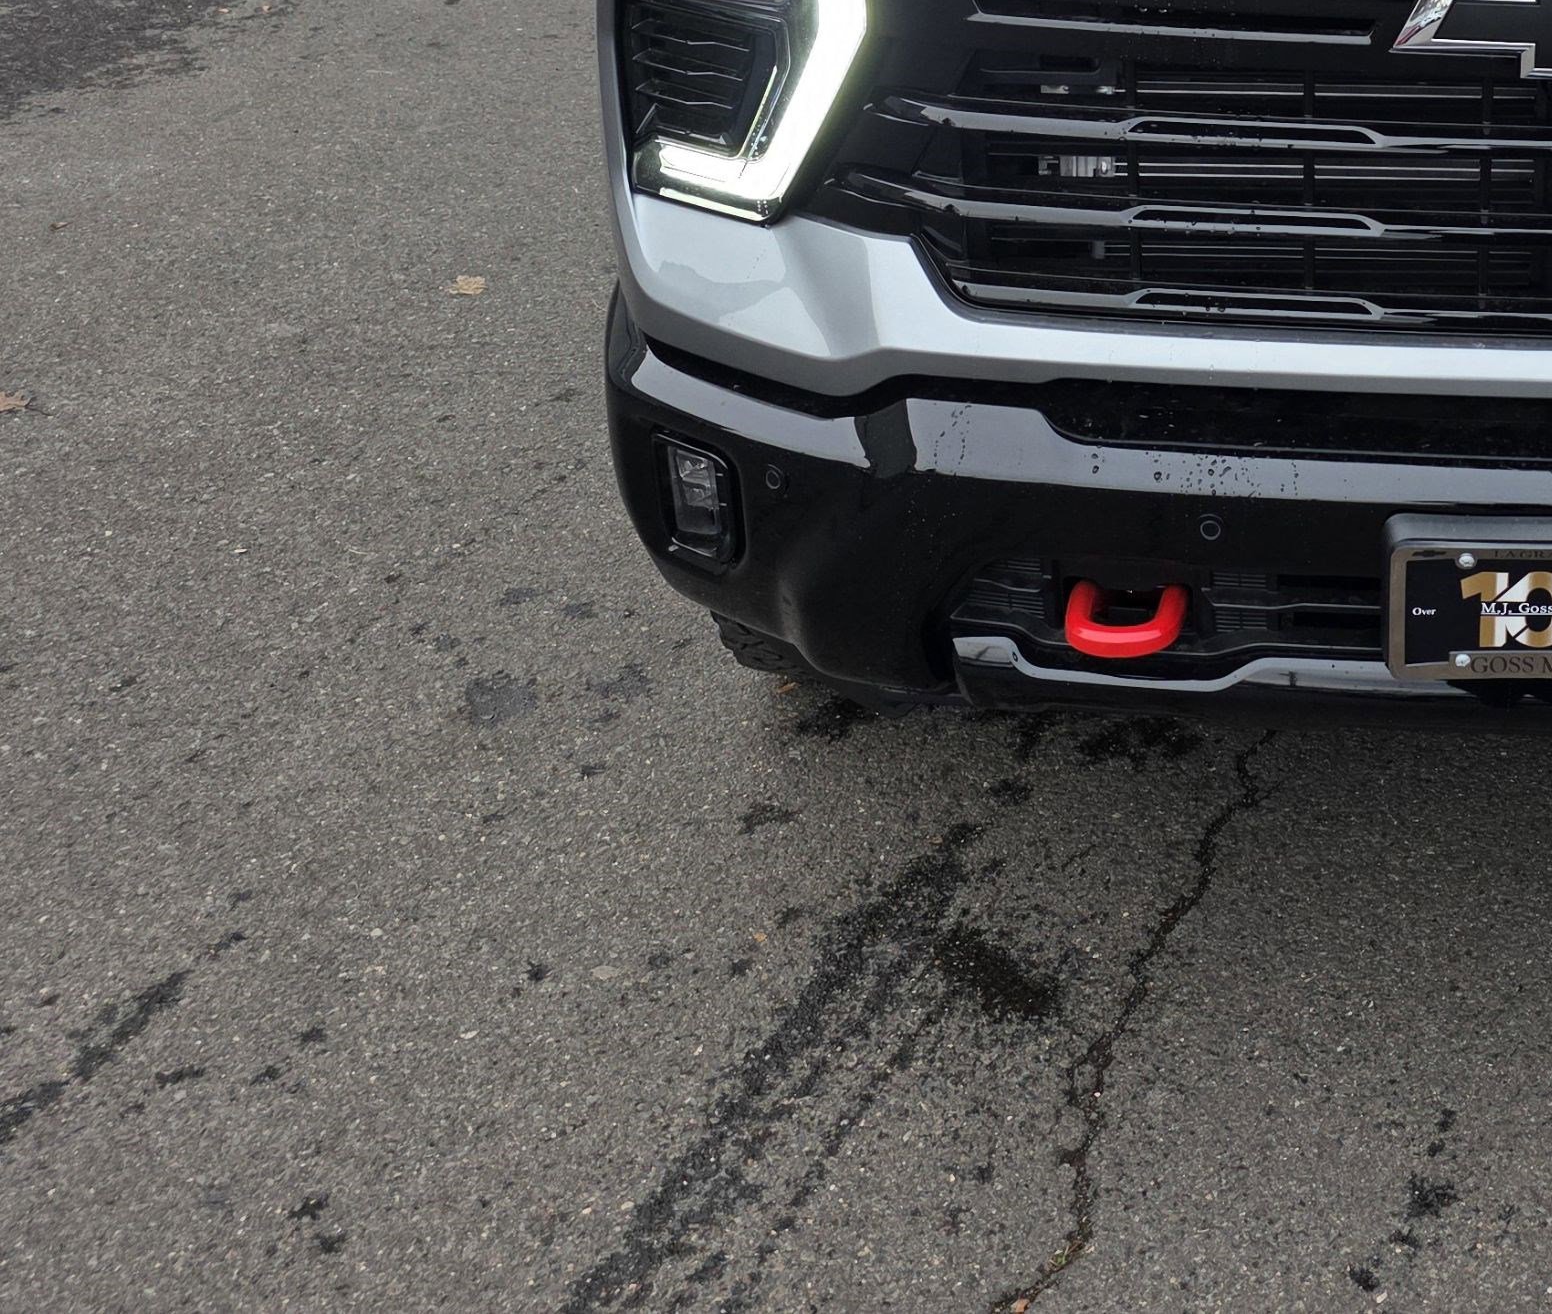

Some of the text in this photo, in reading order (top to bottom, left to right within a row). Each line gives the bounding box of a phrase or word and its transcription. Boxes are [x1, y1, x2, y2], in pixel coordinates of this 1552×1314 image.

[1412, 606, 1437, 616] Over
[1481, 602, 1513, 615] M.J.
[1470, 656, 1535, 674] GOSS
